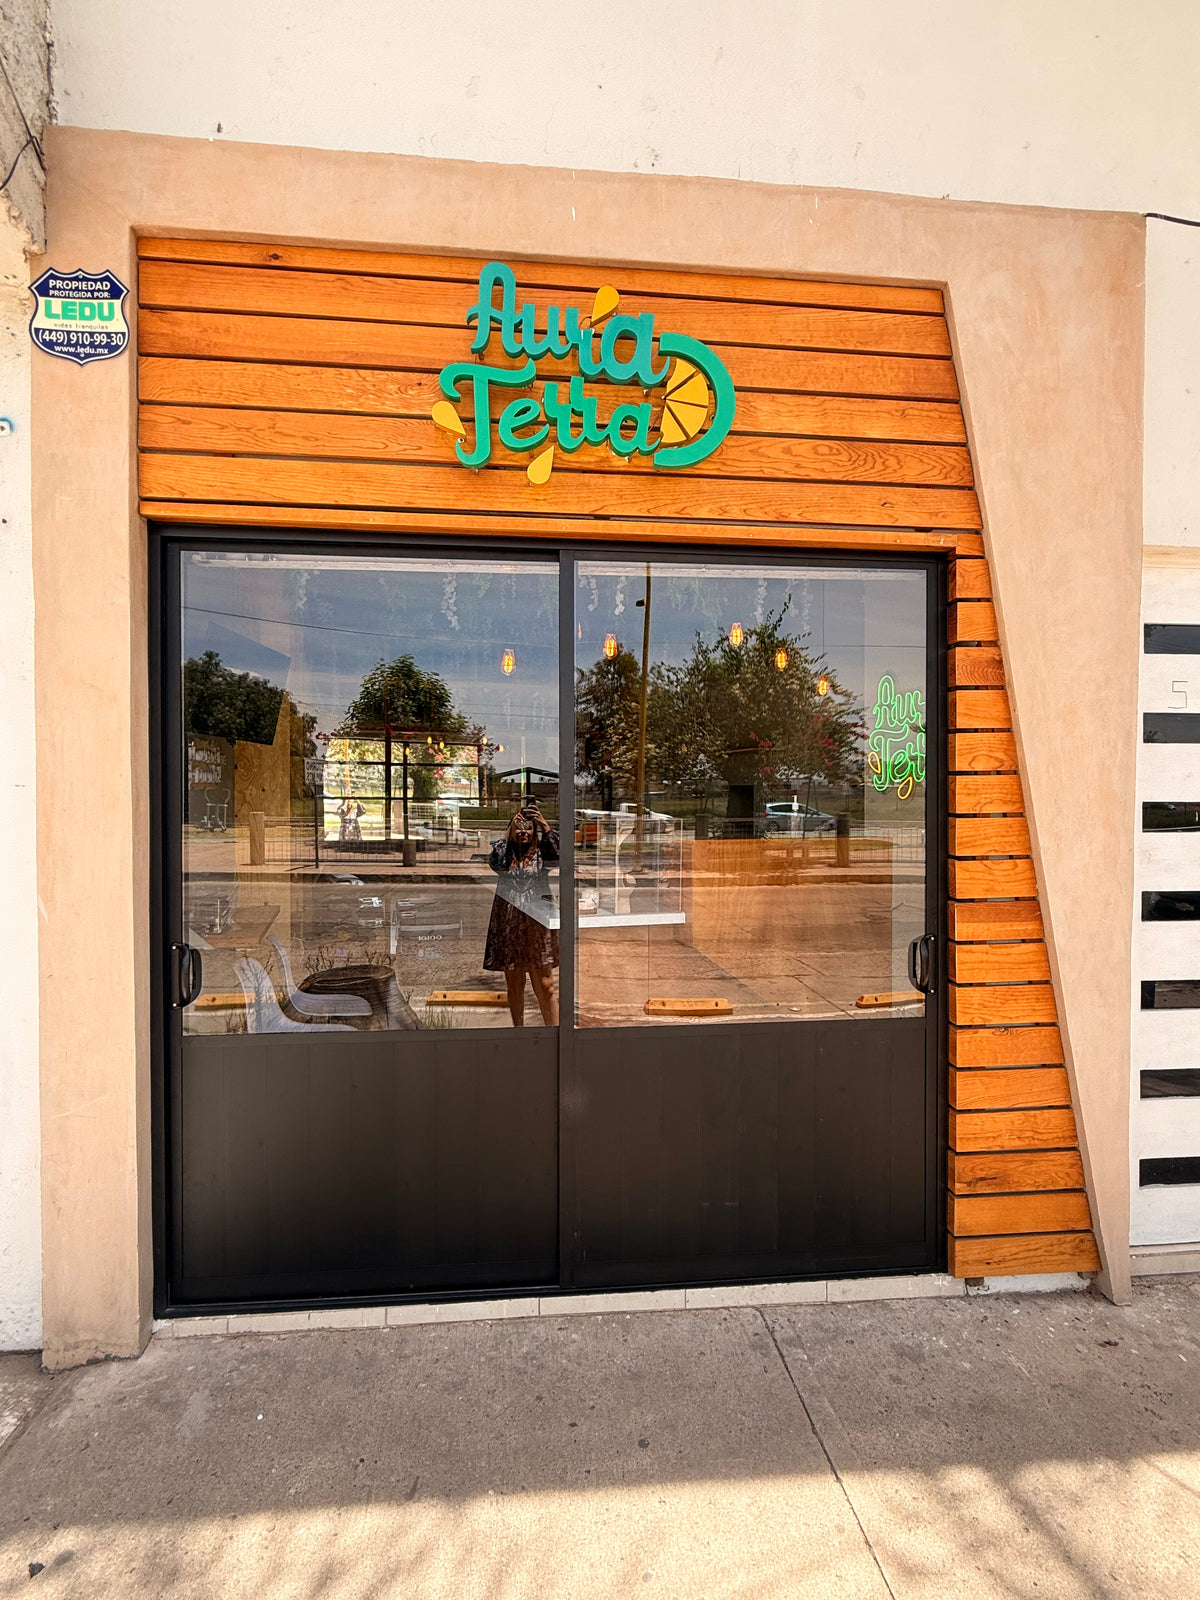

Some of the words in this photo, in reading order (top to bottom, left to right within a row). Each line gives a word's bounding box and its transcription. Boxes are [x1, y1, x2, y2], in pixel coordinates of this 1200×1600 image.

[49, 279, 111, 290] PROPIEDAD
[49, 289, 92, 298] PROTEGIDA
[94, 290, 111, 299] POR:
[44, 299, 115, 322] LEDU
[38, 329, 67, 345] (449)
[69, 332, 123, 346] 910-99-30
[54, 345, 109, 354] www.ledu.mx
[439, 358, 662, 469] Terra
